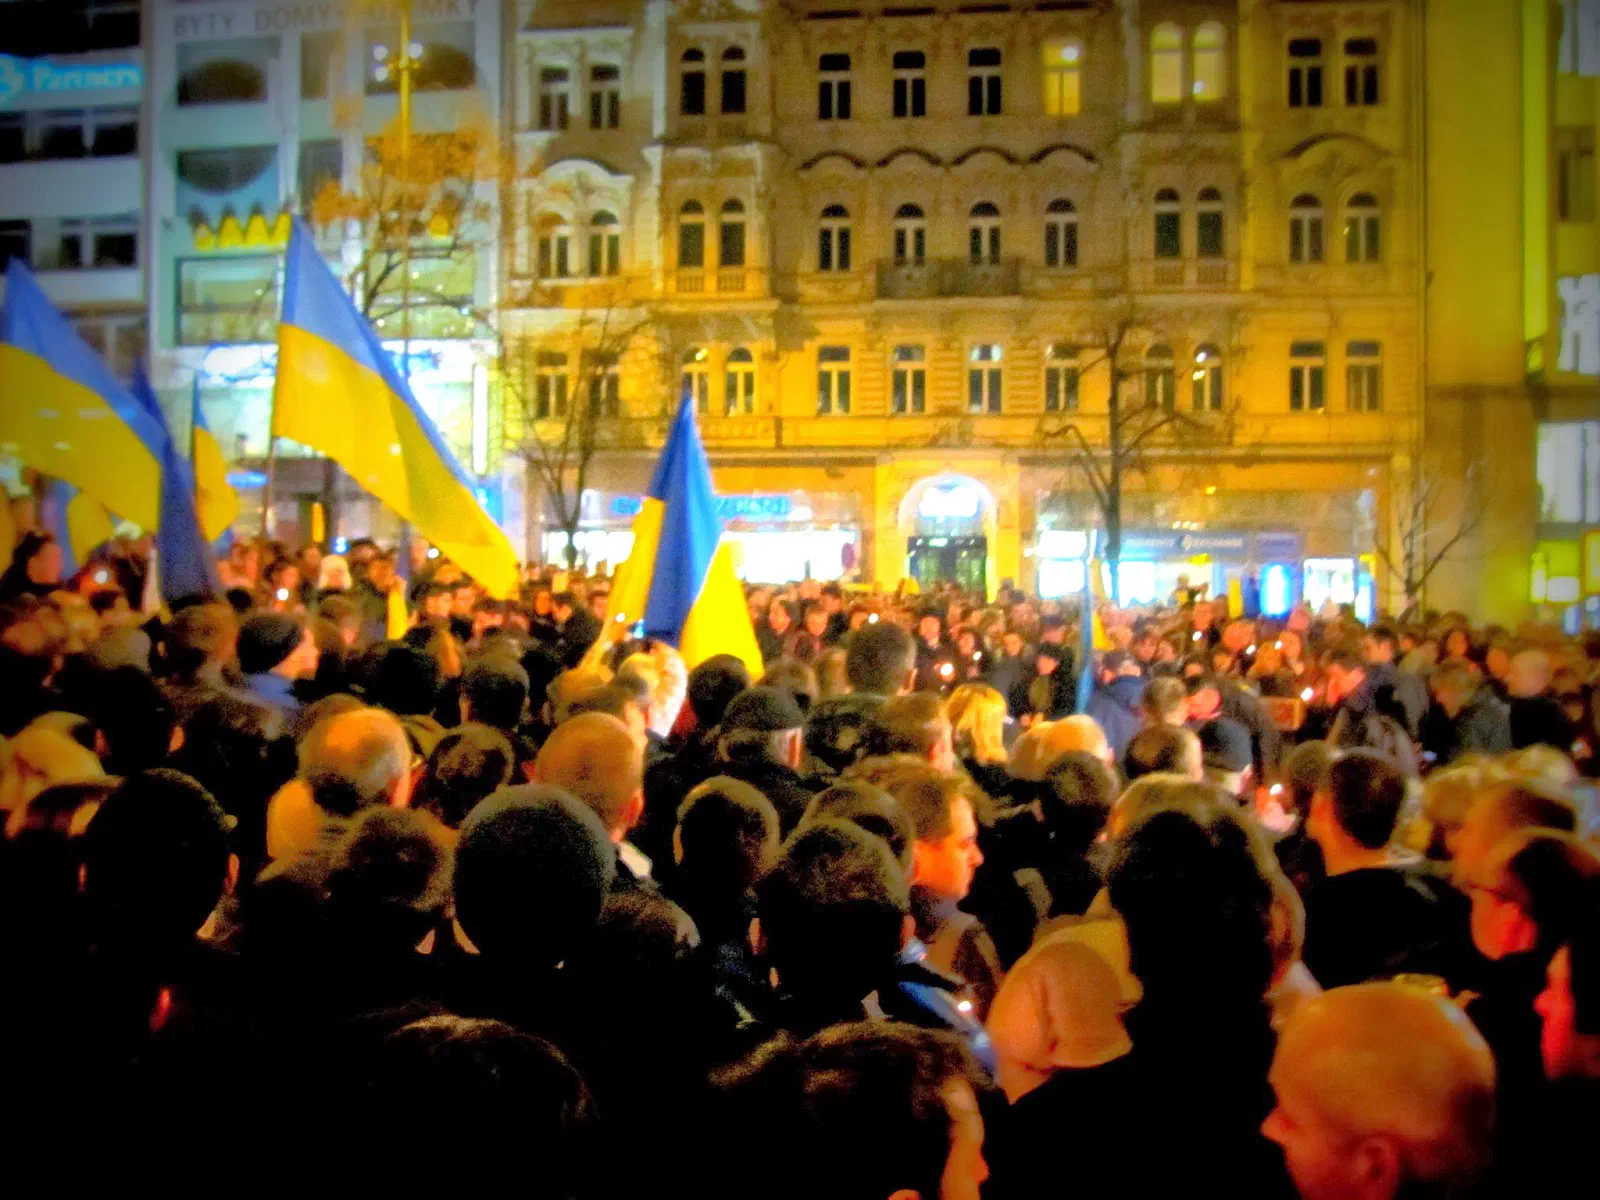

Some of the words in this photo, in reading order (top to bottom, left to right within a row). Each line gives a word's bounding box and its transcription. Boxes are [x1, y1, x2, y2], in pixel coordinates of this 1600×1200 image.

[173, 12, 238, 37] BYTY
[255, 4, 333, 32] DOMY
[32, 63, 140, 90] Partners
